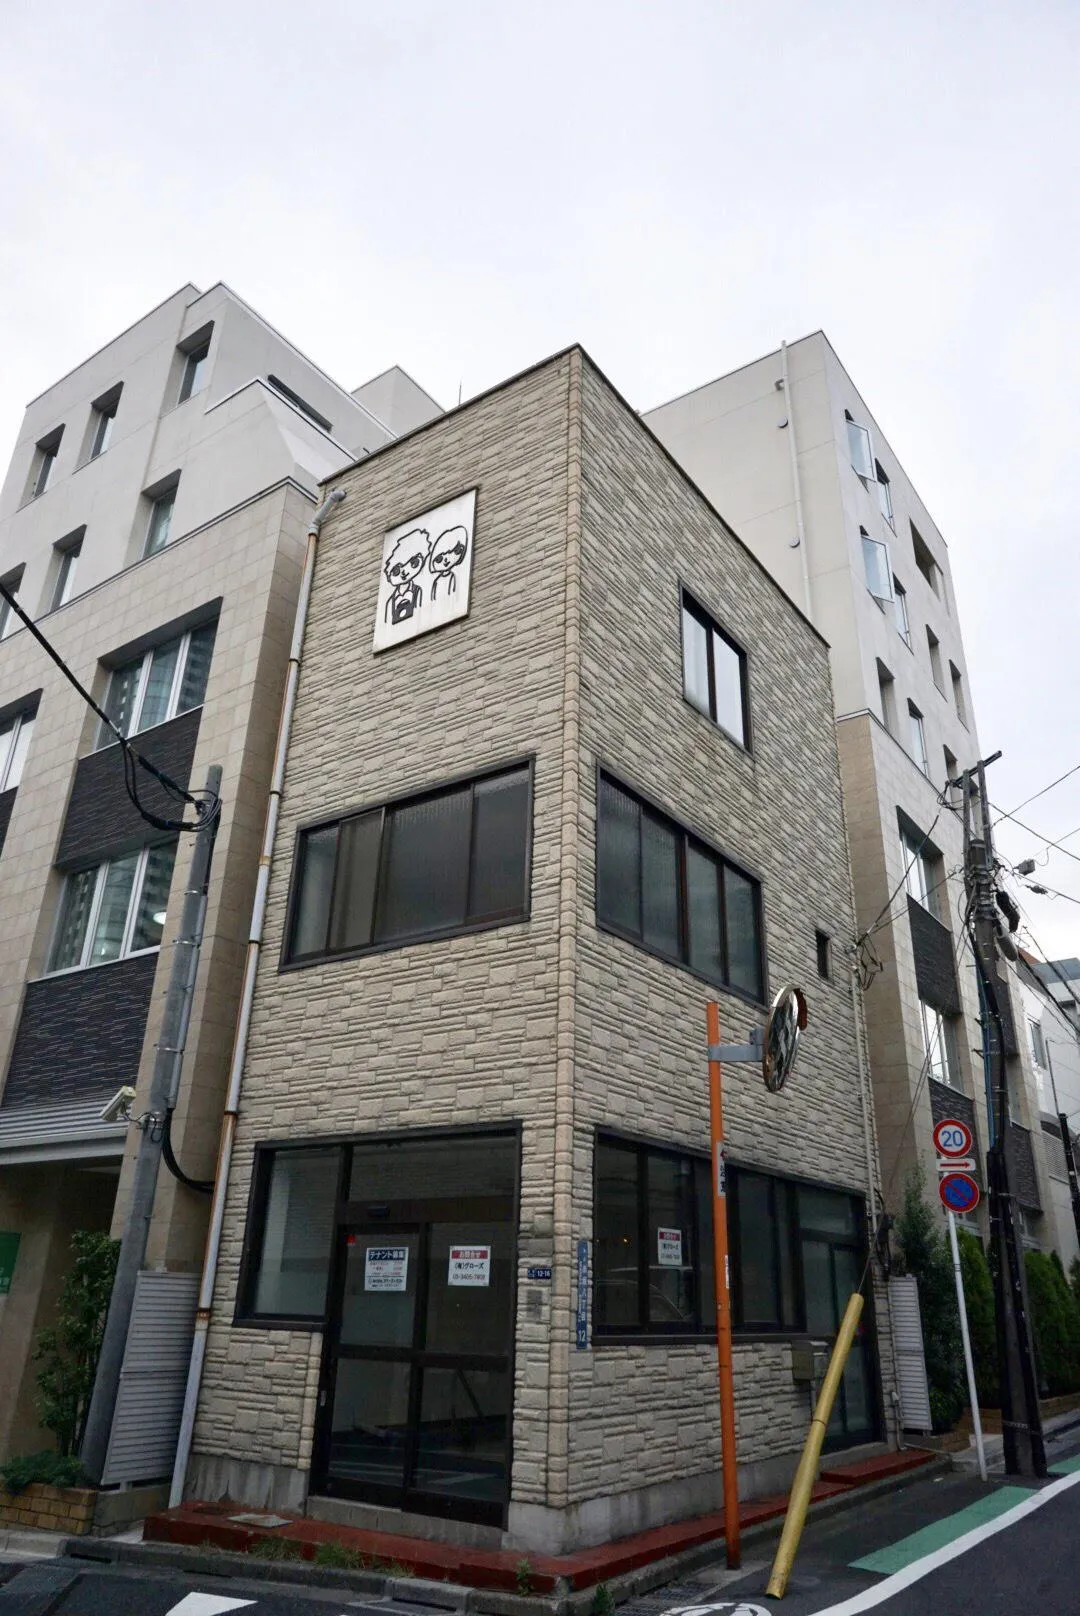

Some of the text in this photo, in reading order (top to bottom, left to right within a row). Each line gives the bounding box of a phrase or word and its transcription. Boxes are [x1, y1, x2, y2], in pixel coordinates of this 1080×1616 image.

[941, 1130, 963, 1147] 20
[370, 1250, 404, 1260] テナント募集
